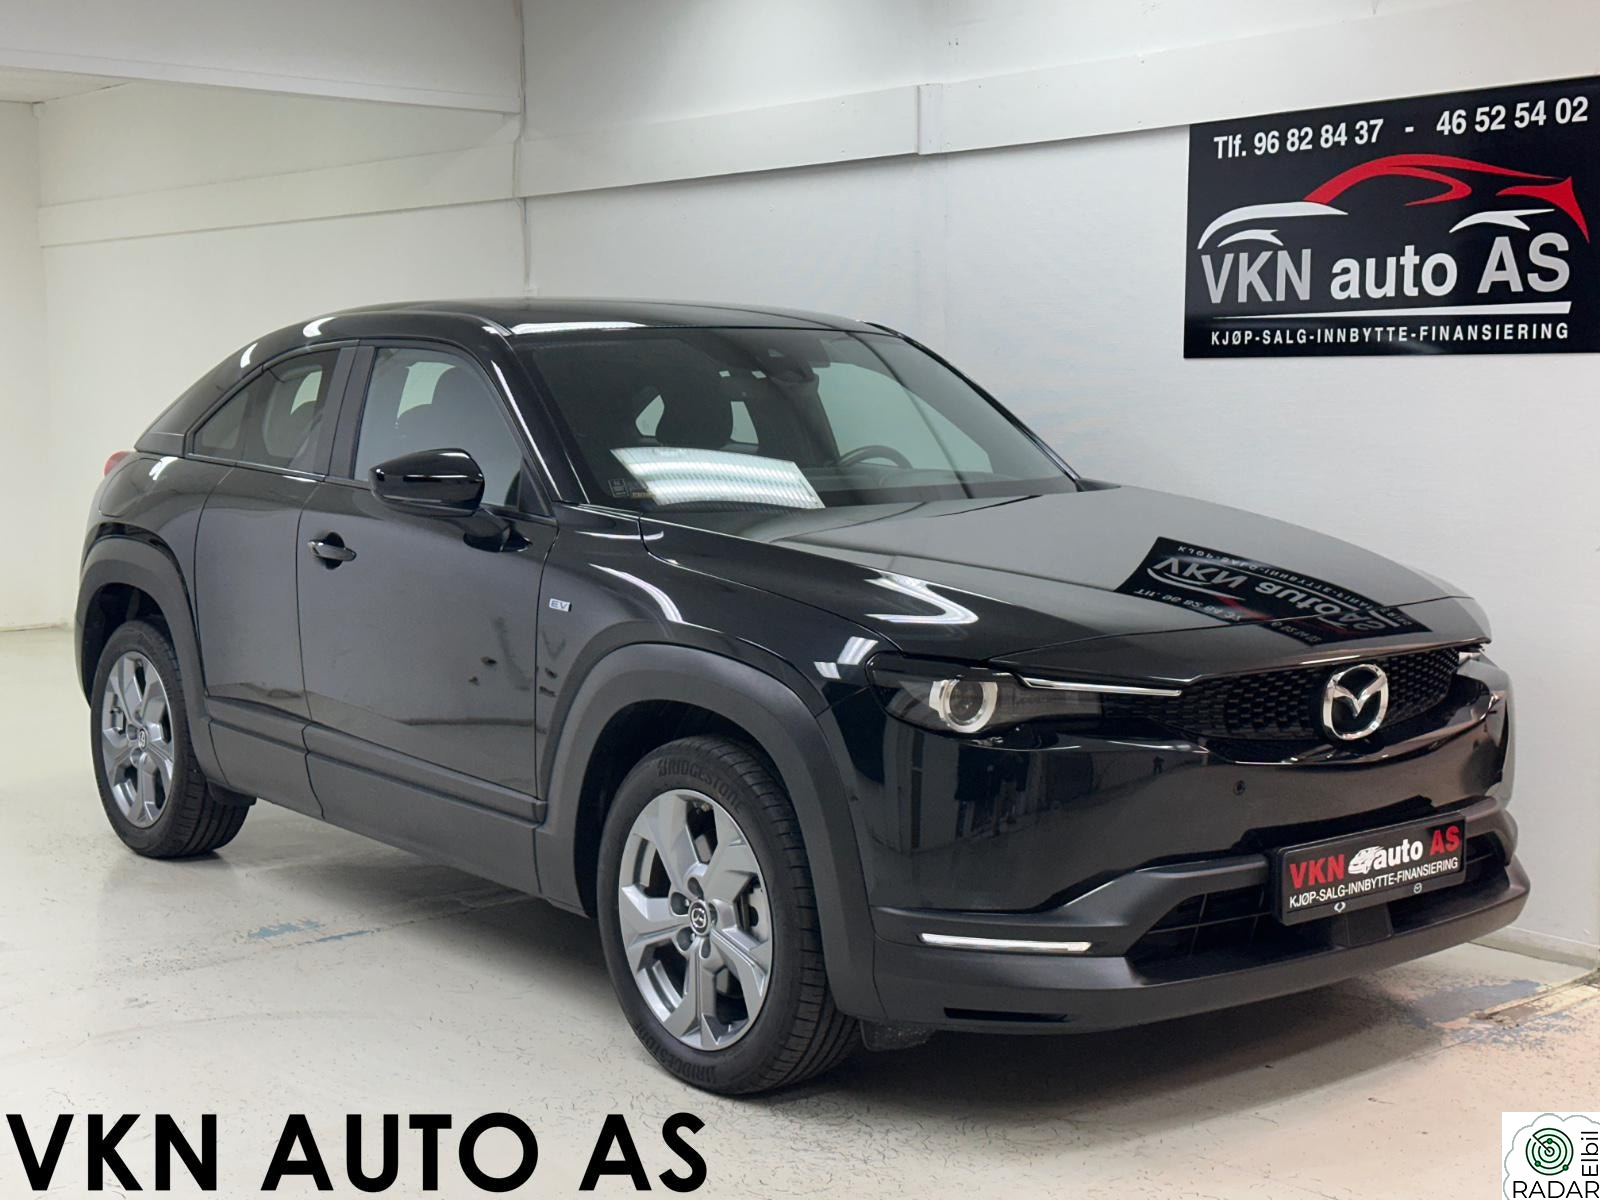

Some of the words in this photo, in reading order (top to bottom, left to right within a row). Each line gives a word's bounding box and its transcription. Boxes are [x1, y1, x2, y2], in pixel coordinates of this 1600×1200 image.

[1214, 135, 1247, 159] Tlf.
[1253, 130, 1280, 156] 96
[1286, 127, 1313, 152] 82
[1320, 123, 1347, 147] 84
[1354, 119, 1384, 144] 37
[1436, 109, 1467, 135] 46
[1474, 105, 1507, 132] 52
[1514, 100, 1546, 127] 54
[1555, 96, 1589, 123] 02
[1201, 248, 1311, 304] VKN
[1330, 244, 1458, 300] auto
[1477, 232, 1570, 294] AS
[1211, 322, 1569, 345] KJØP-SALG-INNBYTTE-FINANSIERING
[550, 600, 569, 610] EV
[1289, 854, 1345, 889] VKN
[1373, 839, 1424, 871] auto
[1429, 825, 1461, 856] AS
[1289, 857, 1458, 908] KJØP-SALG-INNBYTTE-FINANSIERING
